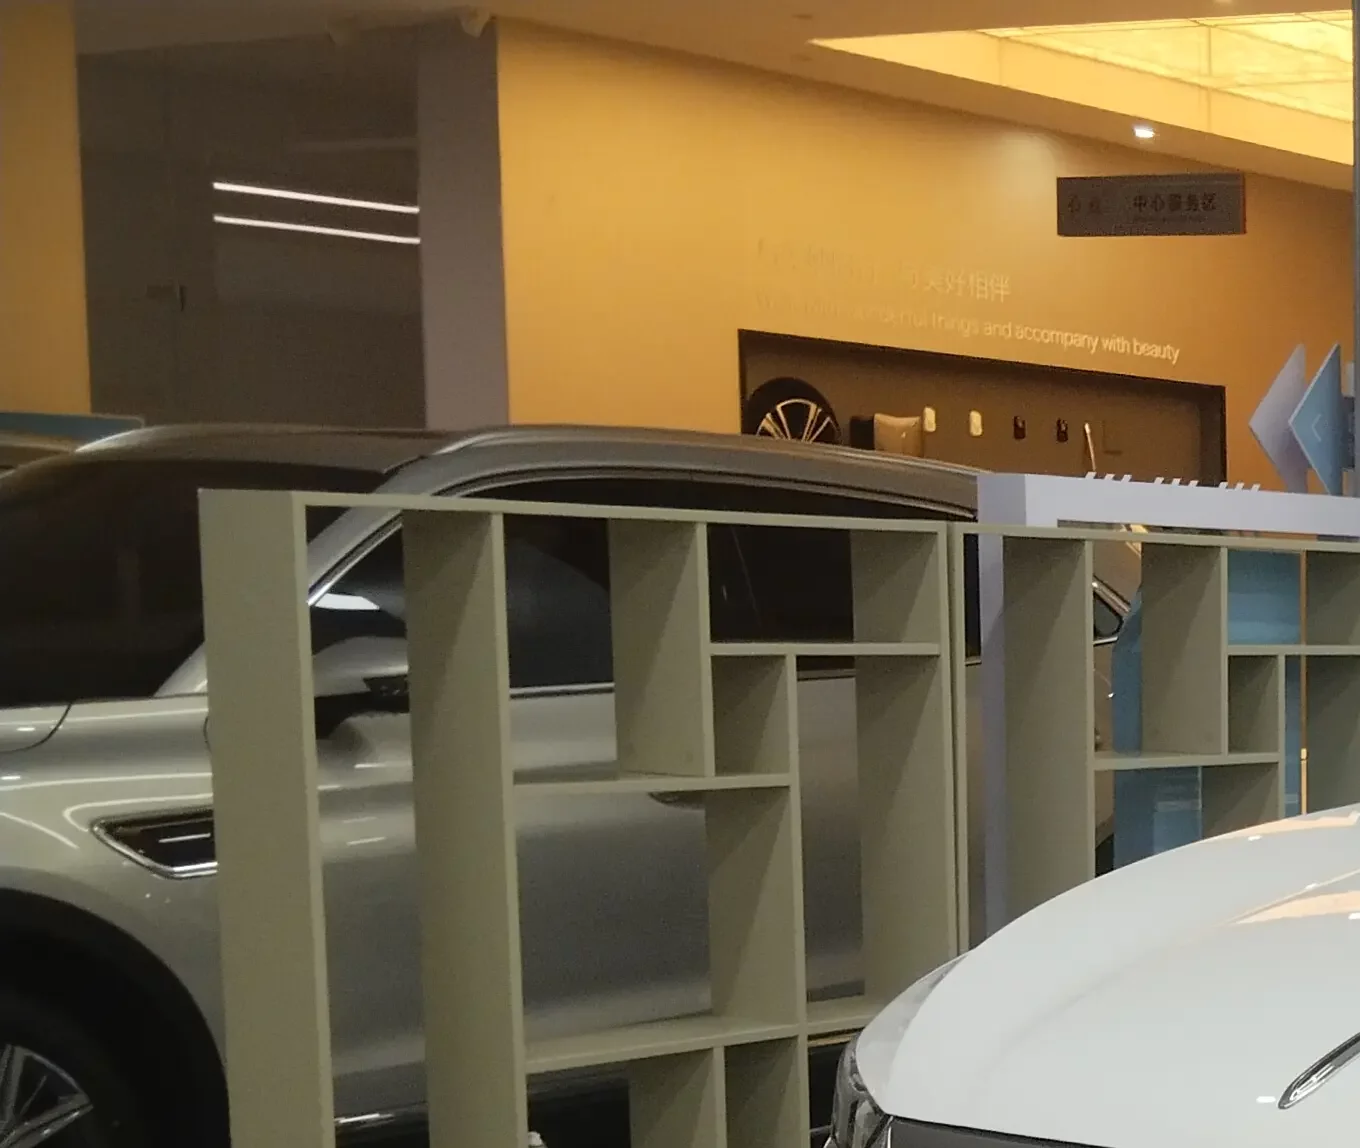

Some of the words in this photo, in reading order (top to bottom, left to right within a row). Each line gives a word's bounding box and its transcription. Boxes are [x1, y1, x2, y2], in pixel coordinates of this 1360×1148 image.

[983, 321, 1012, 340] and
[1015, 324, 1100, 355] accompany
[1102, 334, 1132, 354] with
[1133, 337, 1181, 365] beauty
